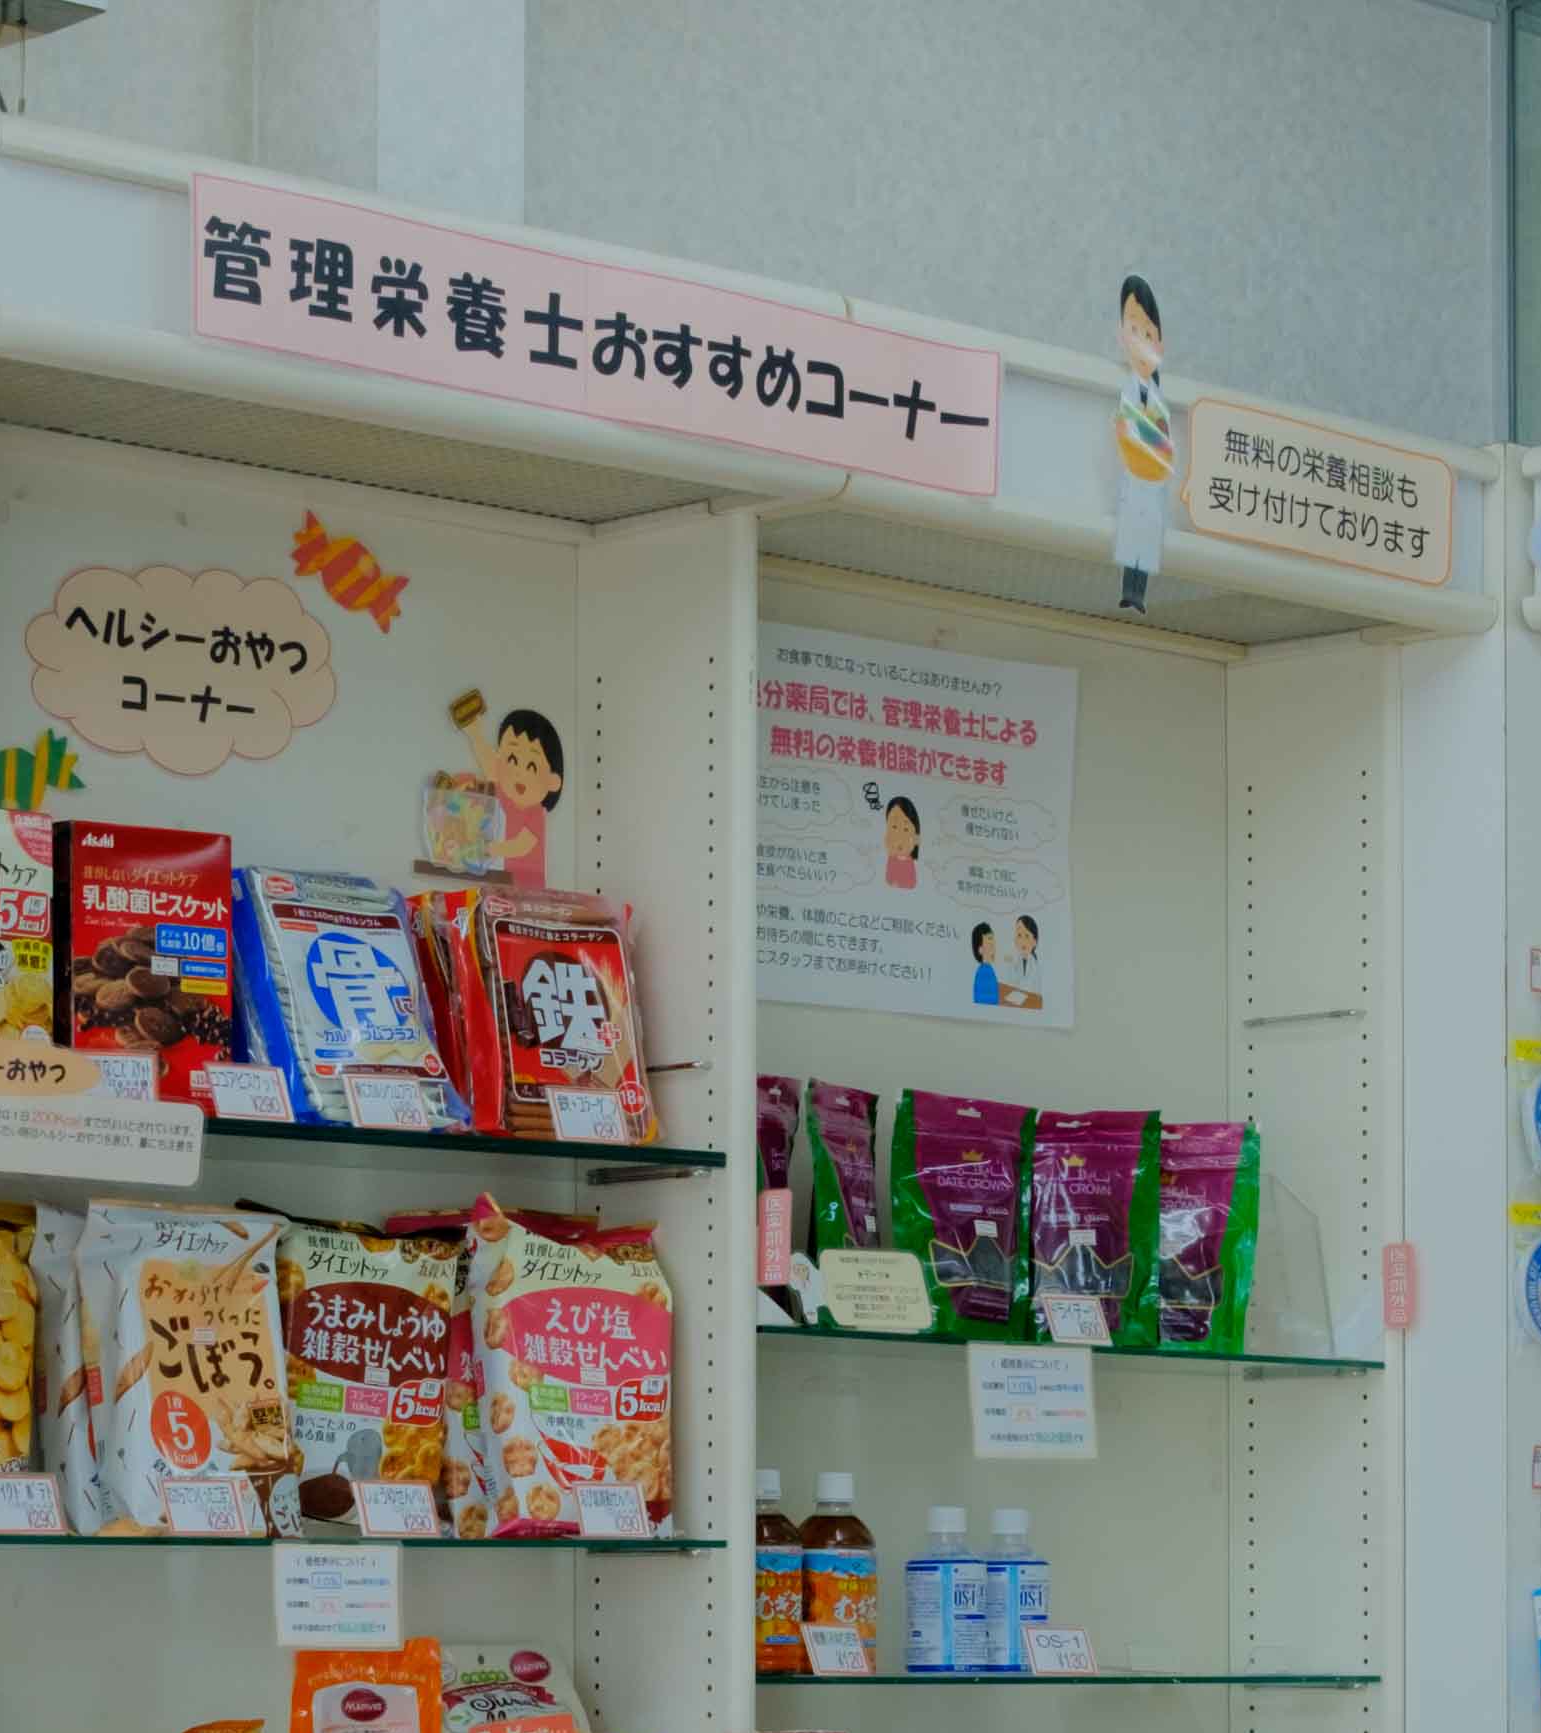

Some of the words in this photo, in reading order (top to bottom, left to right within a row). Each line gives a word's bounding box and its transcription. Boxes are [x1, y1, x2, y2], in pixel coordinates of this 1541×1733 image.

[204, 215, 990, 440] 管理栄養士おすすめコーナー
[1223, 428, 1419, 509] 無料の栄養相談も
[1208, 476, 1430, 560] 受け付けております
[65, 606, 308, 674] ヘルシーおやつ
[121, 676, 255, 725] コーナー
[756, 679, 1037, 747] 分薬局では、管理栄養士による
[770, 726, 1006, 786] 無料の栄養相談ができます
[81, 833, 115, 849] Asahi
[83, 885, 228, 922] 乳酸菌ビスケット
[312, 940, 403, 1027] 骨
[523, 958, 606, 1056] 鉄
[541, 1049, 603, 1071] コラーゲン
[308, 1251, 389, 1279] ダイエットケア
[521, 1260, 602, 1283] ダイエットケア
[306, 1291, 446, 1341] うまみしょうゆ
[546, 1297, 636, 1341] えび塩
[301, 1328, 445, 1374] 雑穀せんべい
[523, 1334, 668, 1371] 雑穀せんべい
[394, 1388, 415, 1420] 5
[618, 1388, 639, 1420] 5
[167, 1413, 195, 1449] 5
[1035, 1634, 1082, 1650] OS-1
